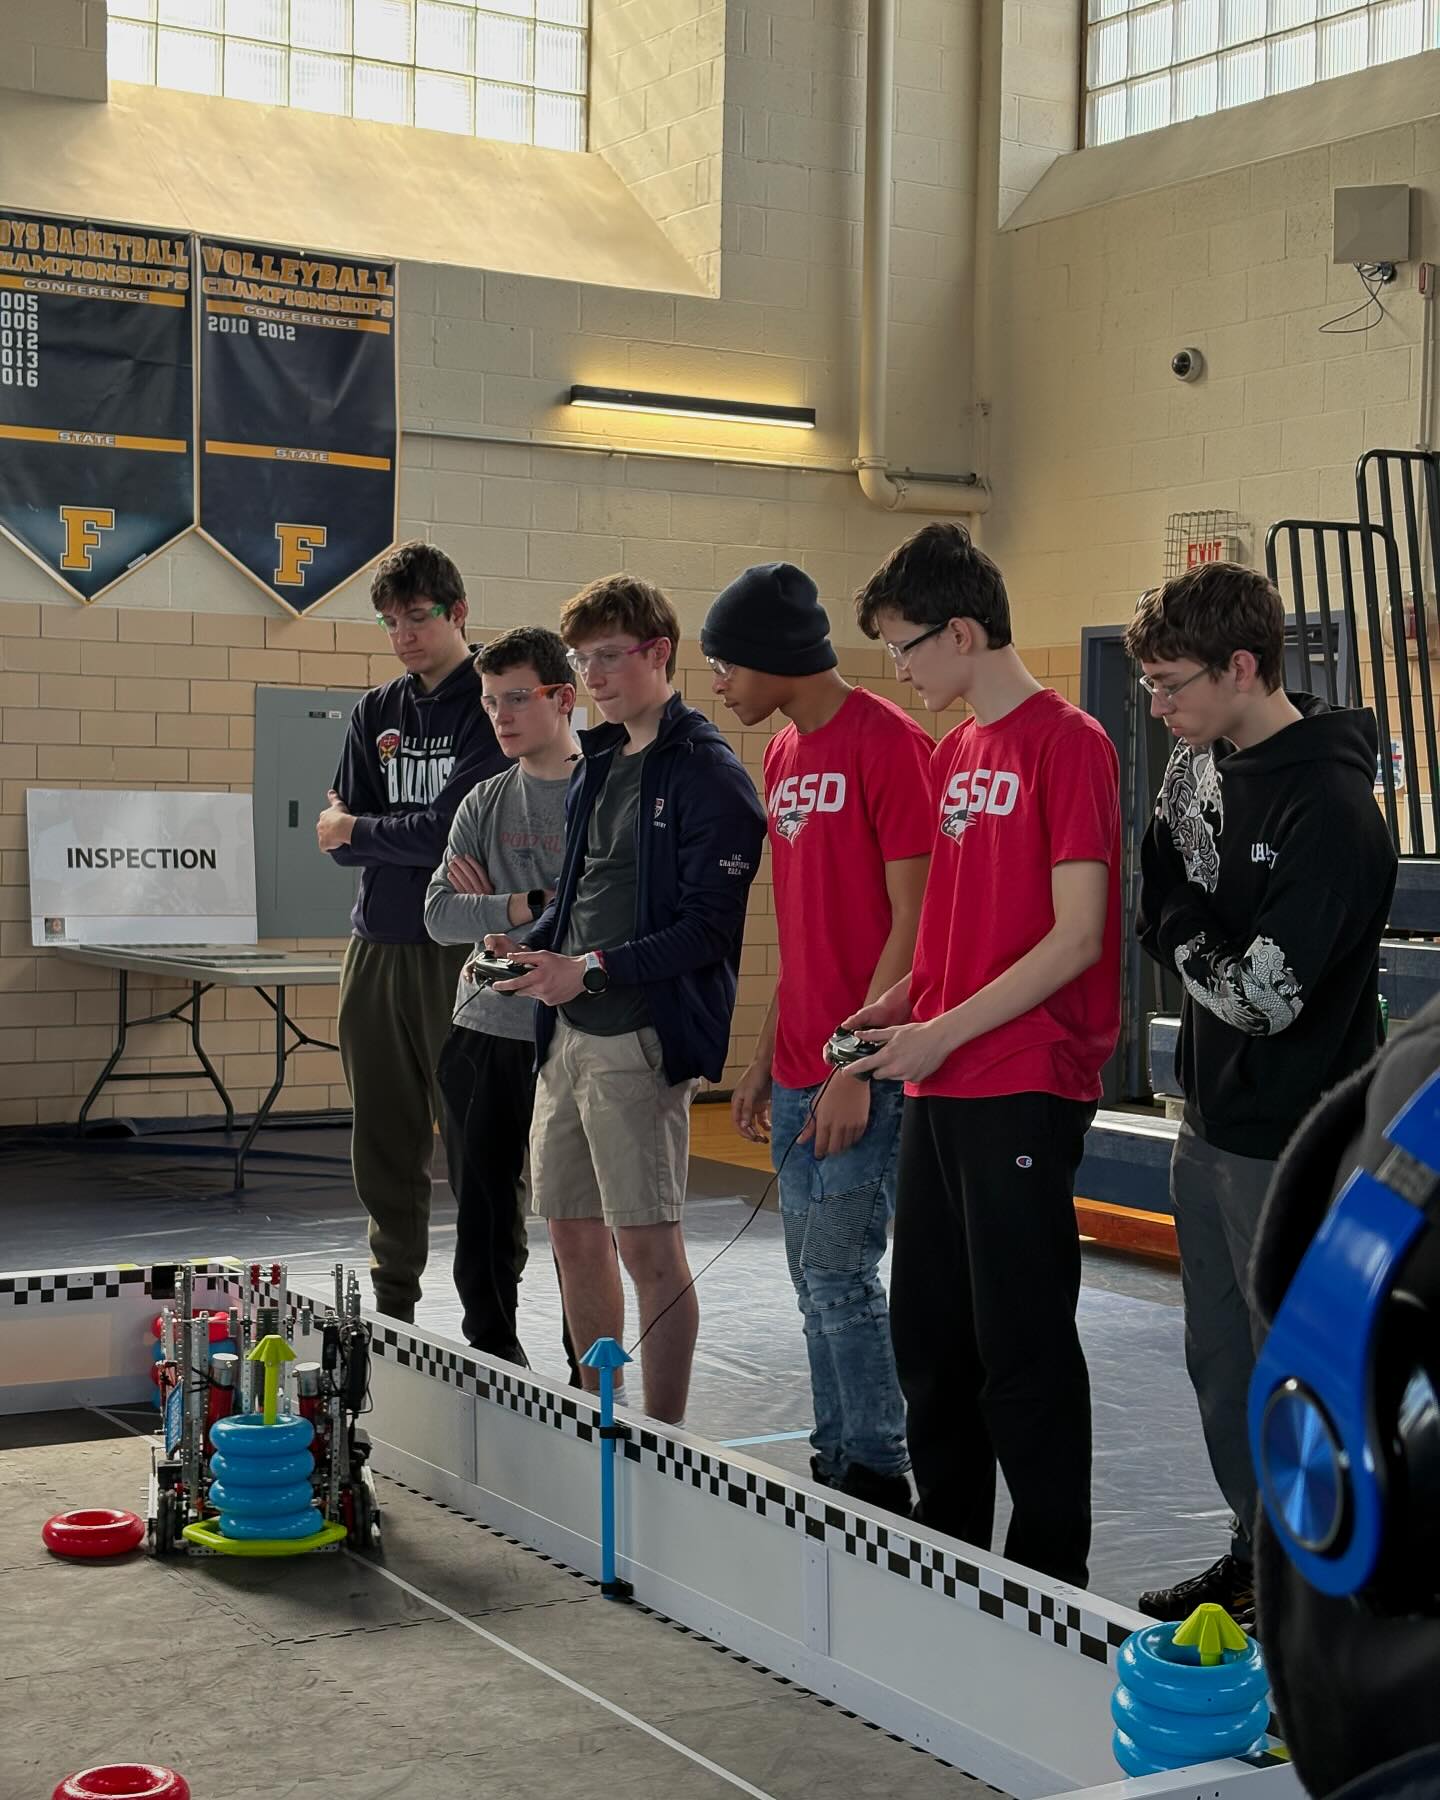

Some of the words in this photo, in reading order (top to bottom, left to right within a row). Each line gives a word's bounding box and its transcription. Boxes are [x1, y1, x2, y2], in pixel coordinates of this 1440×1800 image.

[43, 225, 189, 268] BASKETBALL
[202, 246, 394, 297] VOLLEYBALL
[24, 279, 150, 301] CONFERENCE
[202, 276, 393, 318] CHAMPIONSHIPS
[207, 316, 249, 334] 2010
[257, 321, 296, 341] 2012
[243, 304, 358, 329] CONFERENCE
[58, 431, 116, 446] STATE
[275, 448, 329, 463] STATE
[60, 505, 115, 571] F
[274, 522, 327, 586] F
[1187, 541, 1223, 569] EXIT
[943, 768, 1020, 816] SSD
[67, 847, 217, 870] INSPECTION
[719, 859, 750, 870] CHAMPIONS
